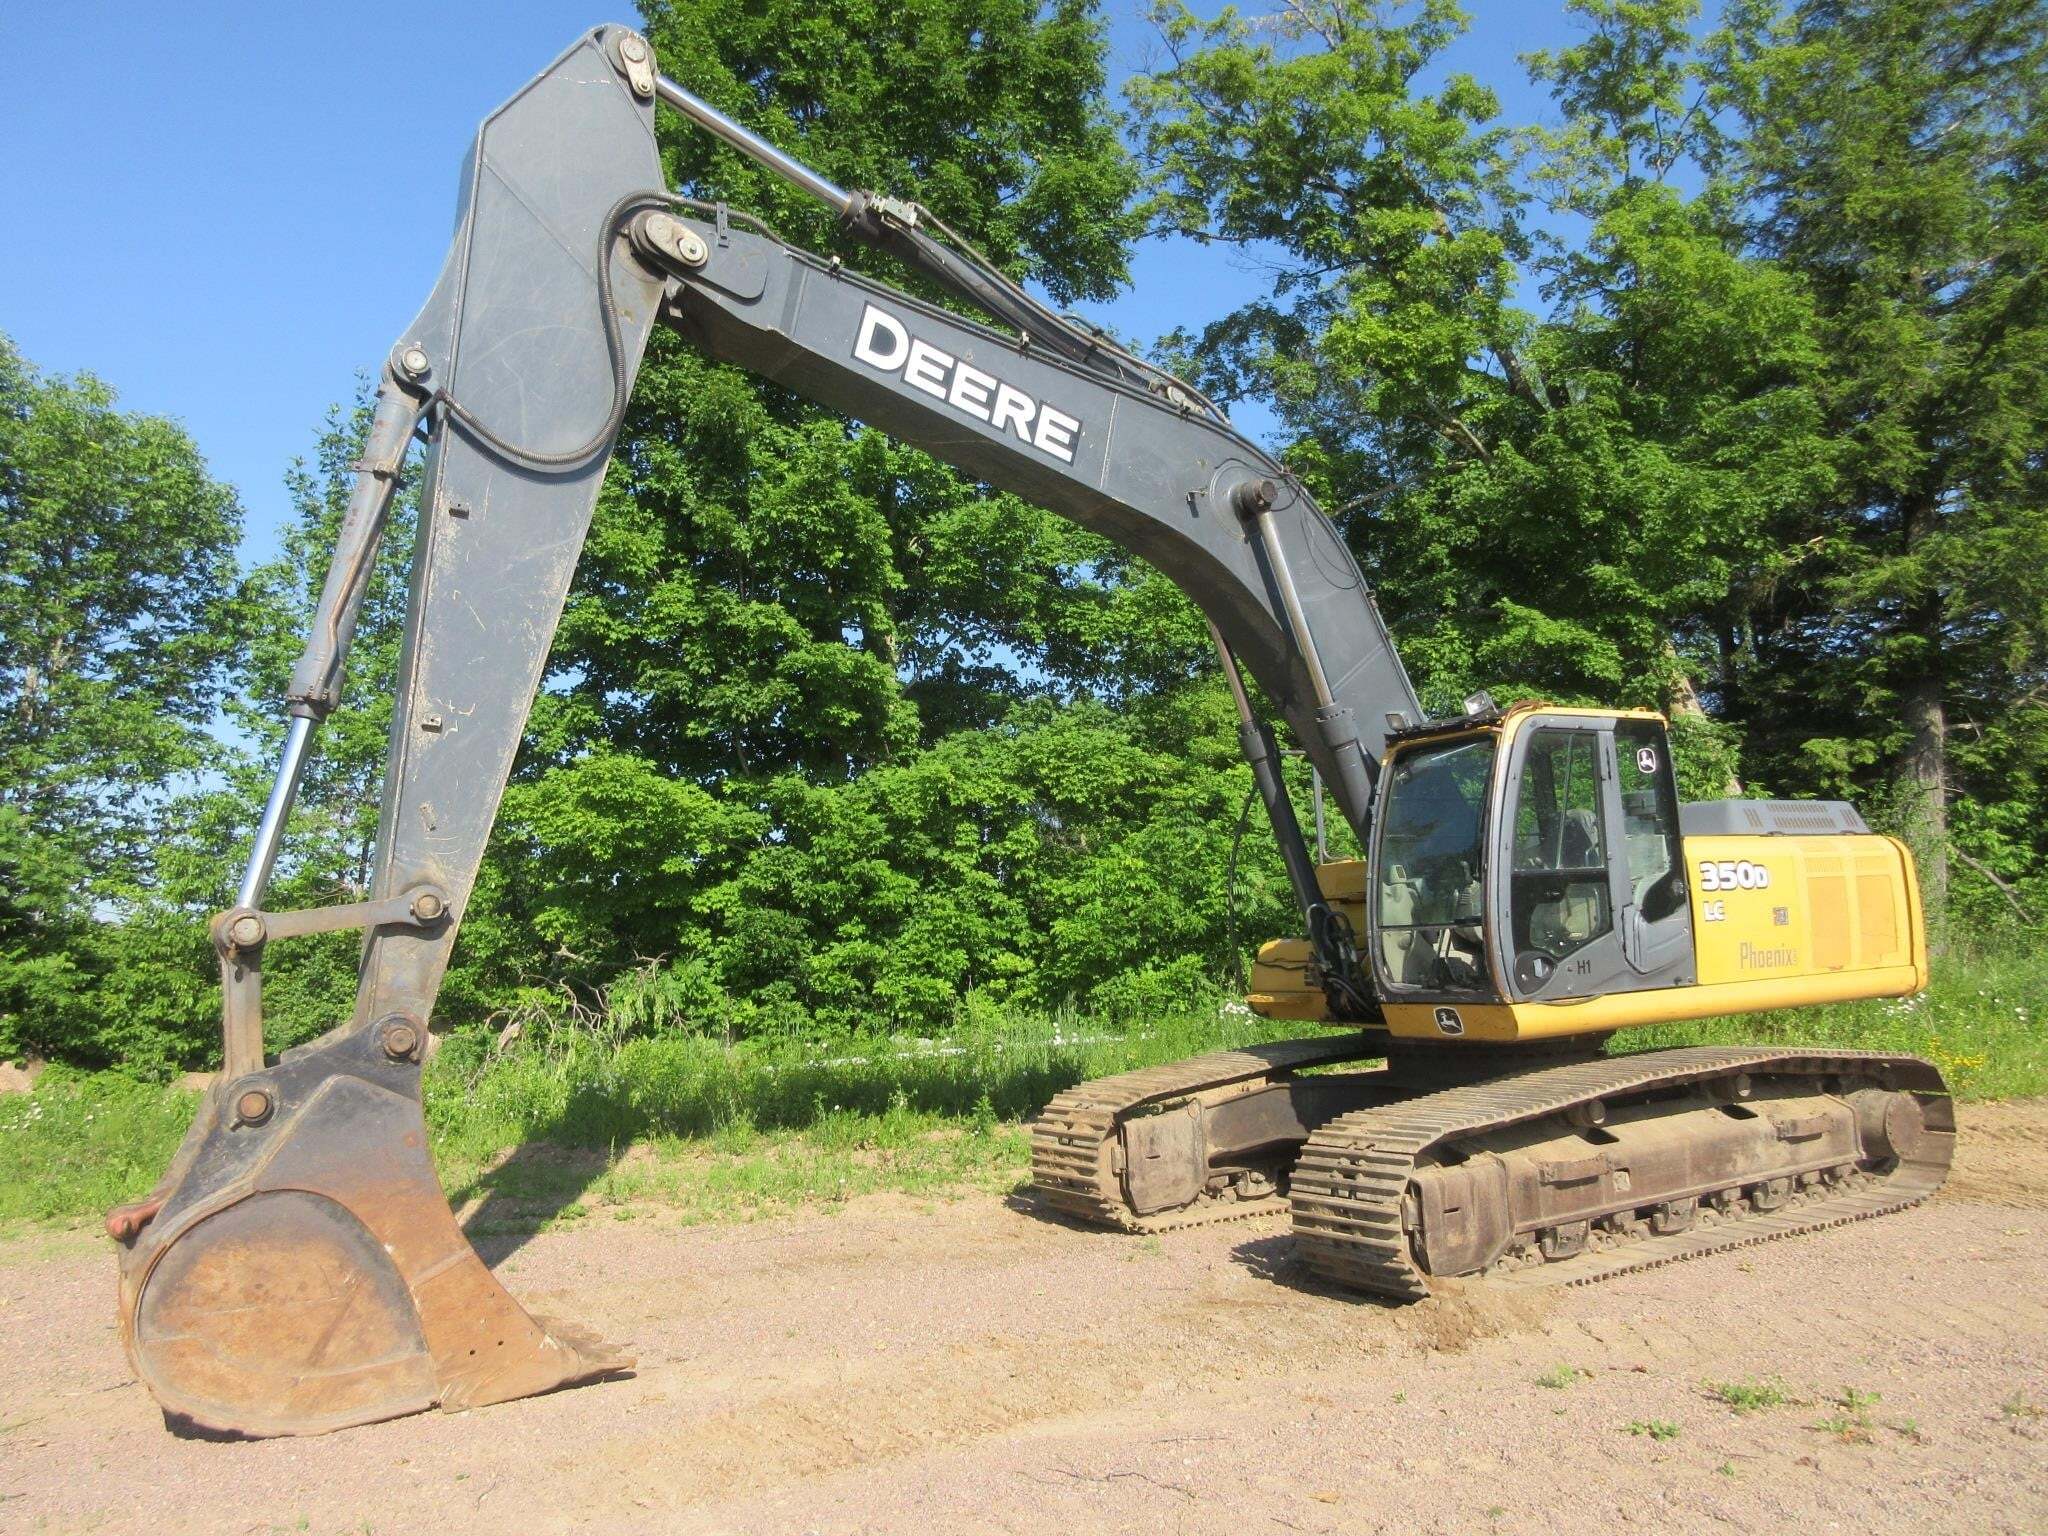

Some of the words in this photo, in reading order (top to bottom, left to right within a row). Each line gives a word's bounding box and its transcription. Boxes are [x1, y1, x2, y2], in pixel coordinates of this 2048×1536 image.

[853, 303, 1081, 464] DEERE
[1699, 860, 1768, 892] 350D
[1703, 900, 1725, 922] LC
[1740, 942, 1792, 969] Phoenix
